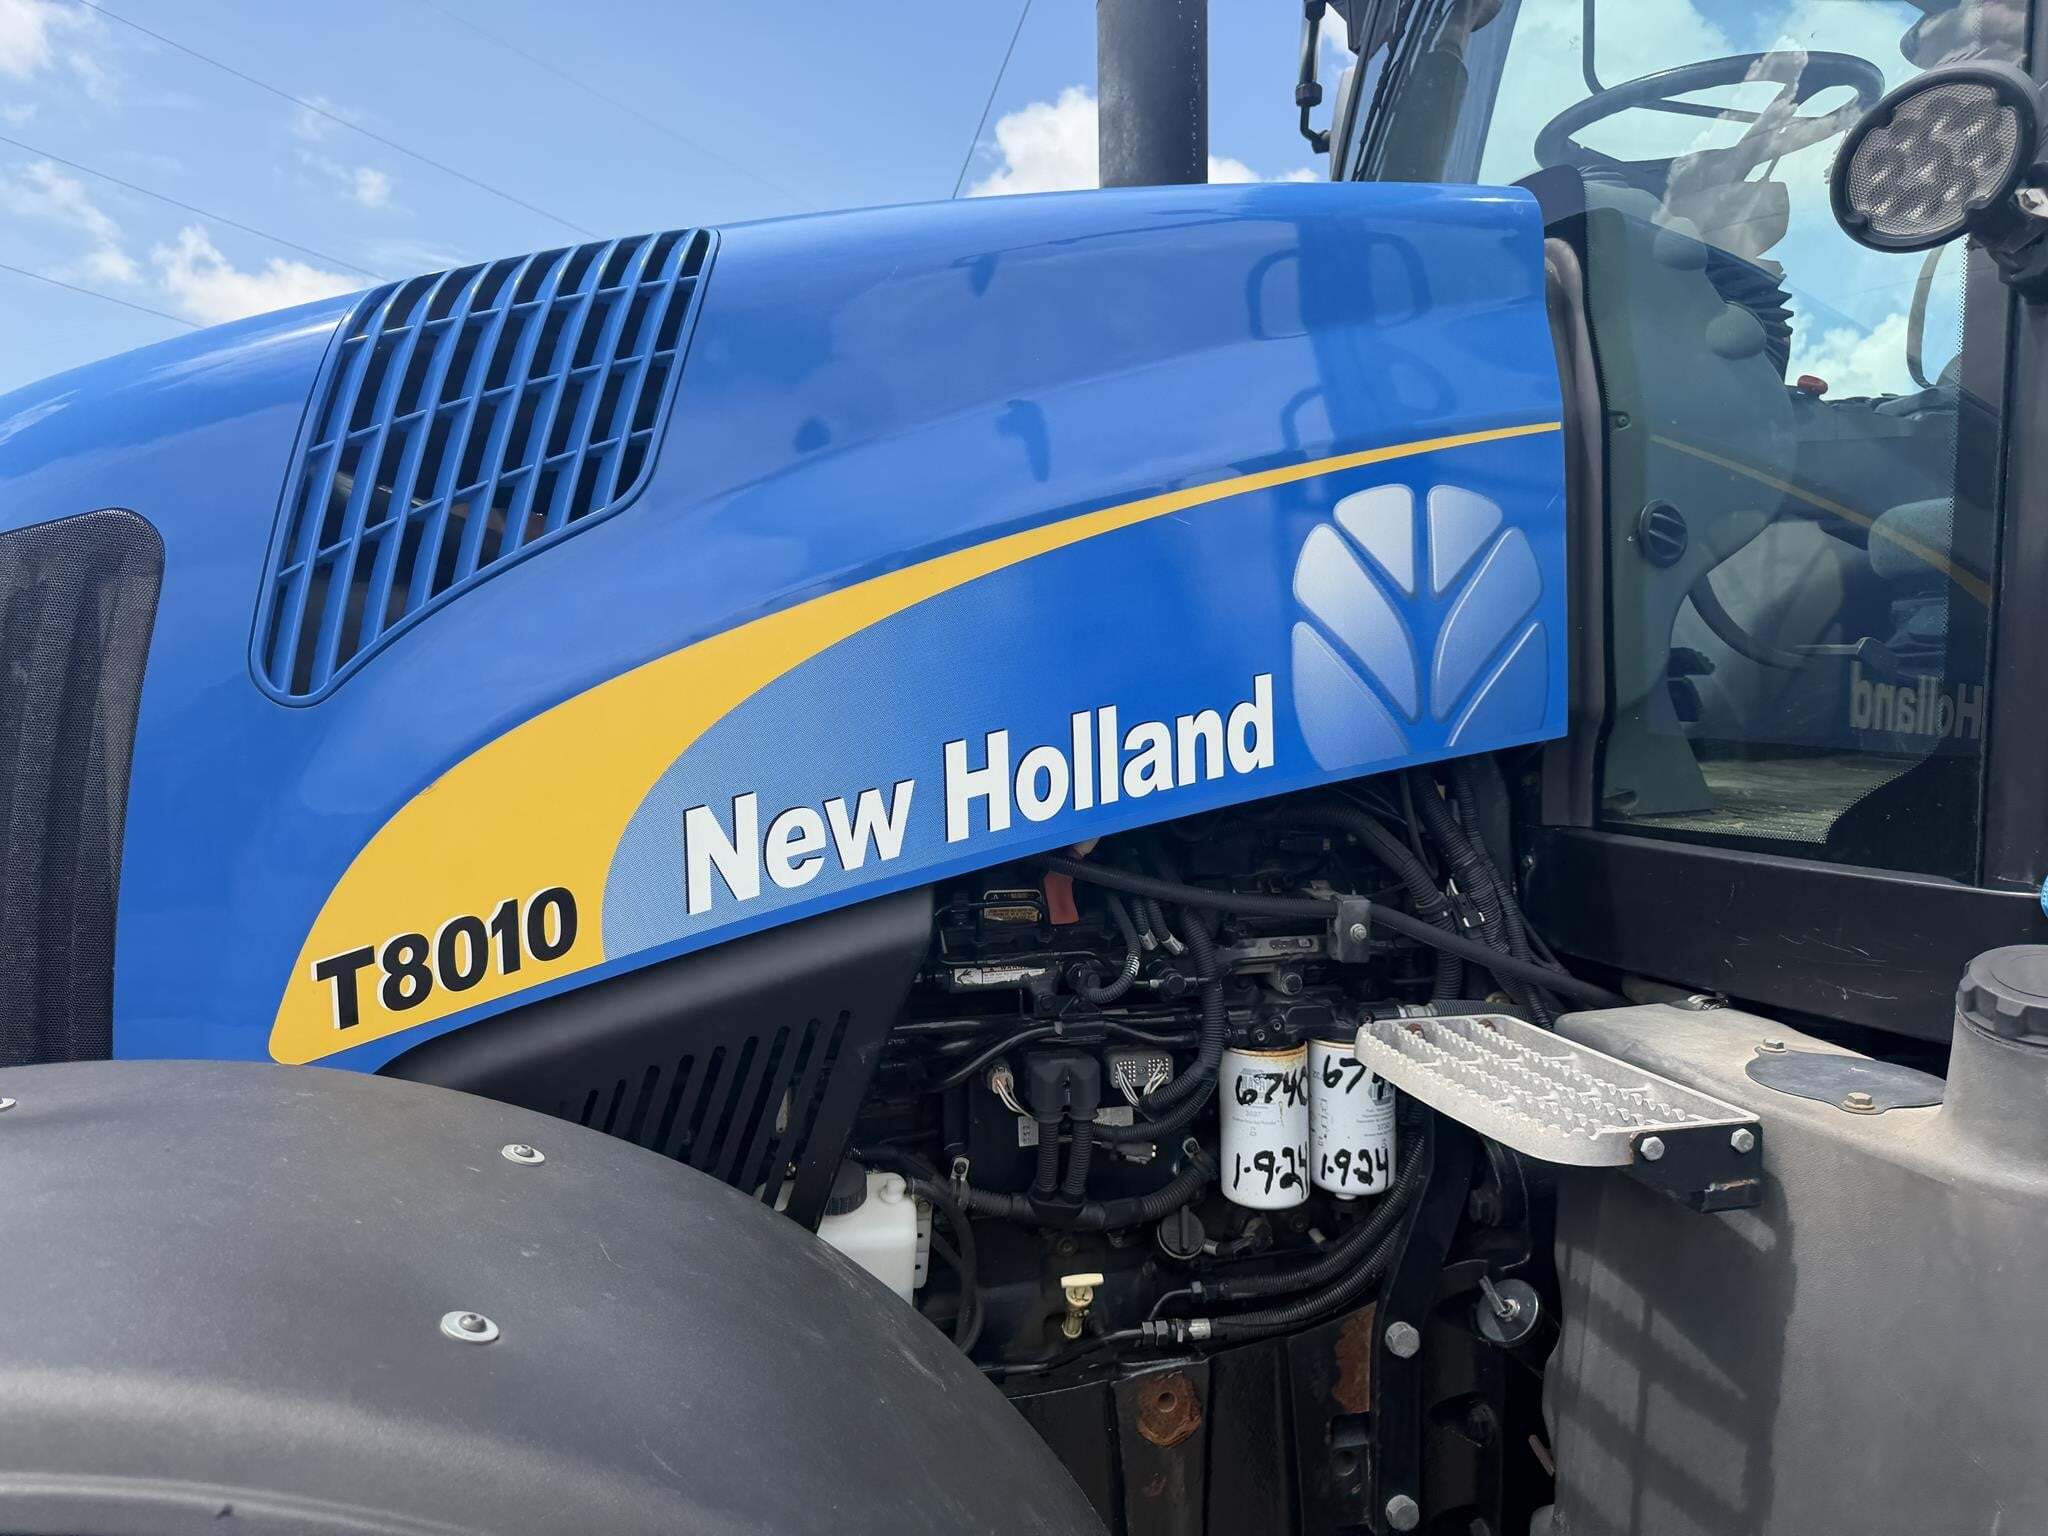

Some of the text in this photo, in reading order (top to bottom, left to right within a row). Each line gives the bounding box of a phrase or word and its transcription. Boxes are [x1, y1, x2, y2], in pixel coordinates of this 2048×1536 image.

[684, 672, 1275, 915] New Holland
[310, 886, 579, 1031] T8010
